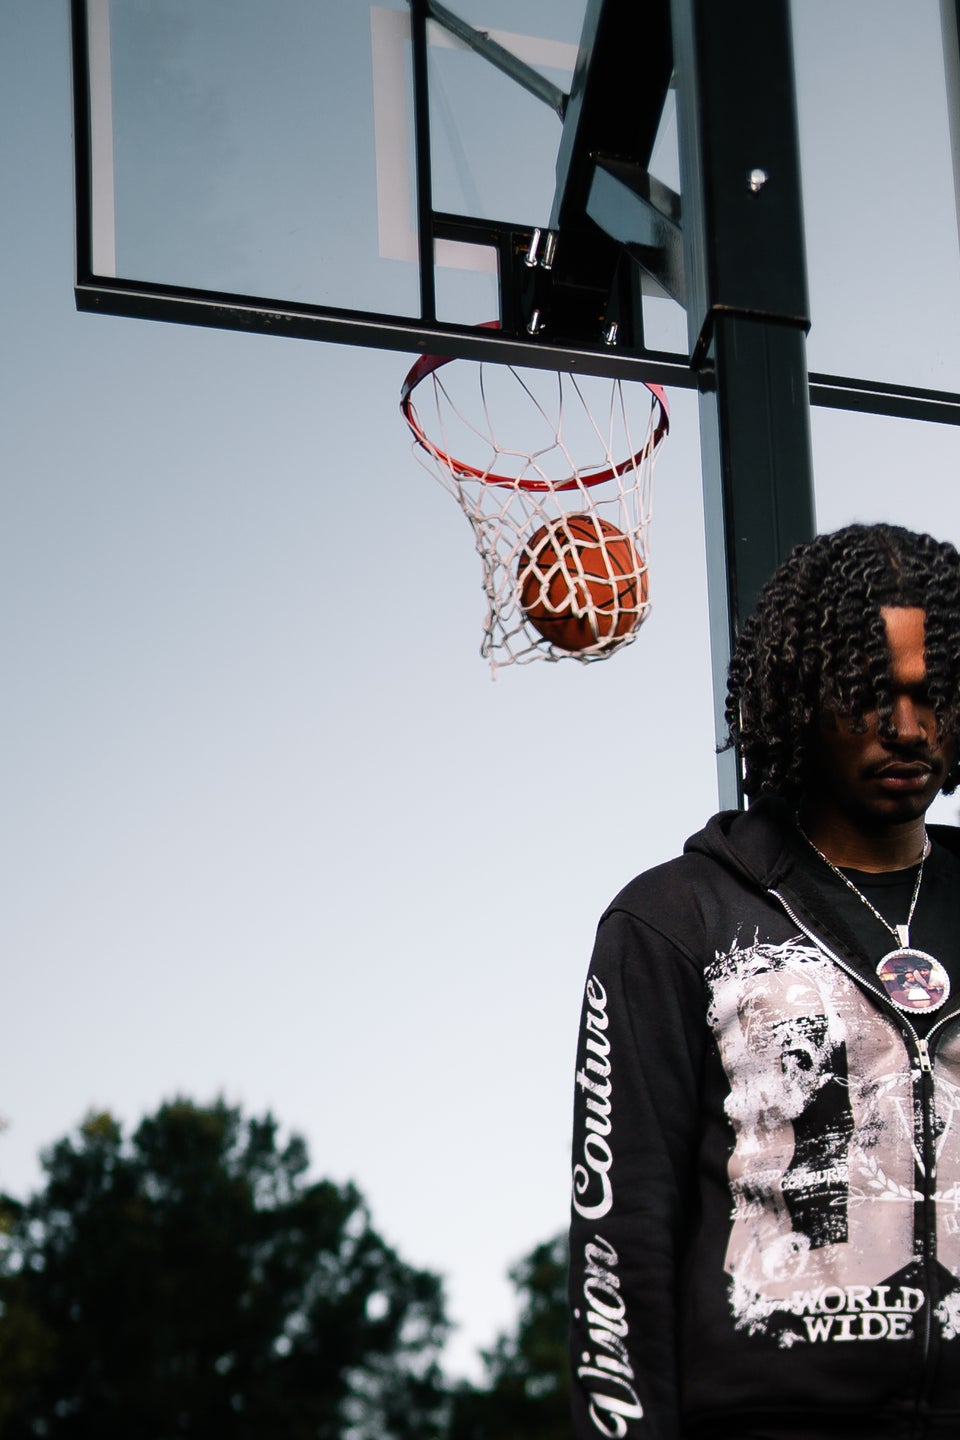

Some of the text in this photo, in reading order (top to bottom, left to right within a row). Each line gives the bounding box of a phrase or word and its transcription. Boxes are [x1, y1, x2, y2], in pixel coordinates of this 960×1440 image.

[572, 974, 644, 1440] Vision Couture
[791, 1286, 925, 1316] WORLD
[803, 1312, 914, 1343] WIDE
